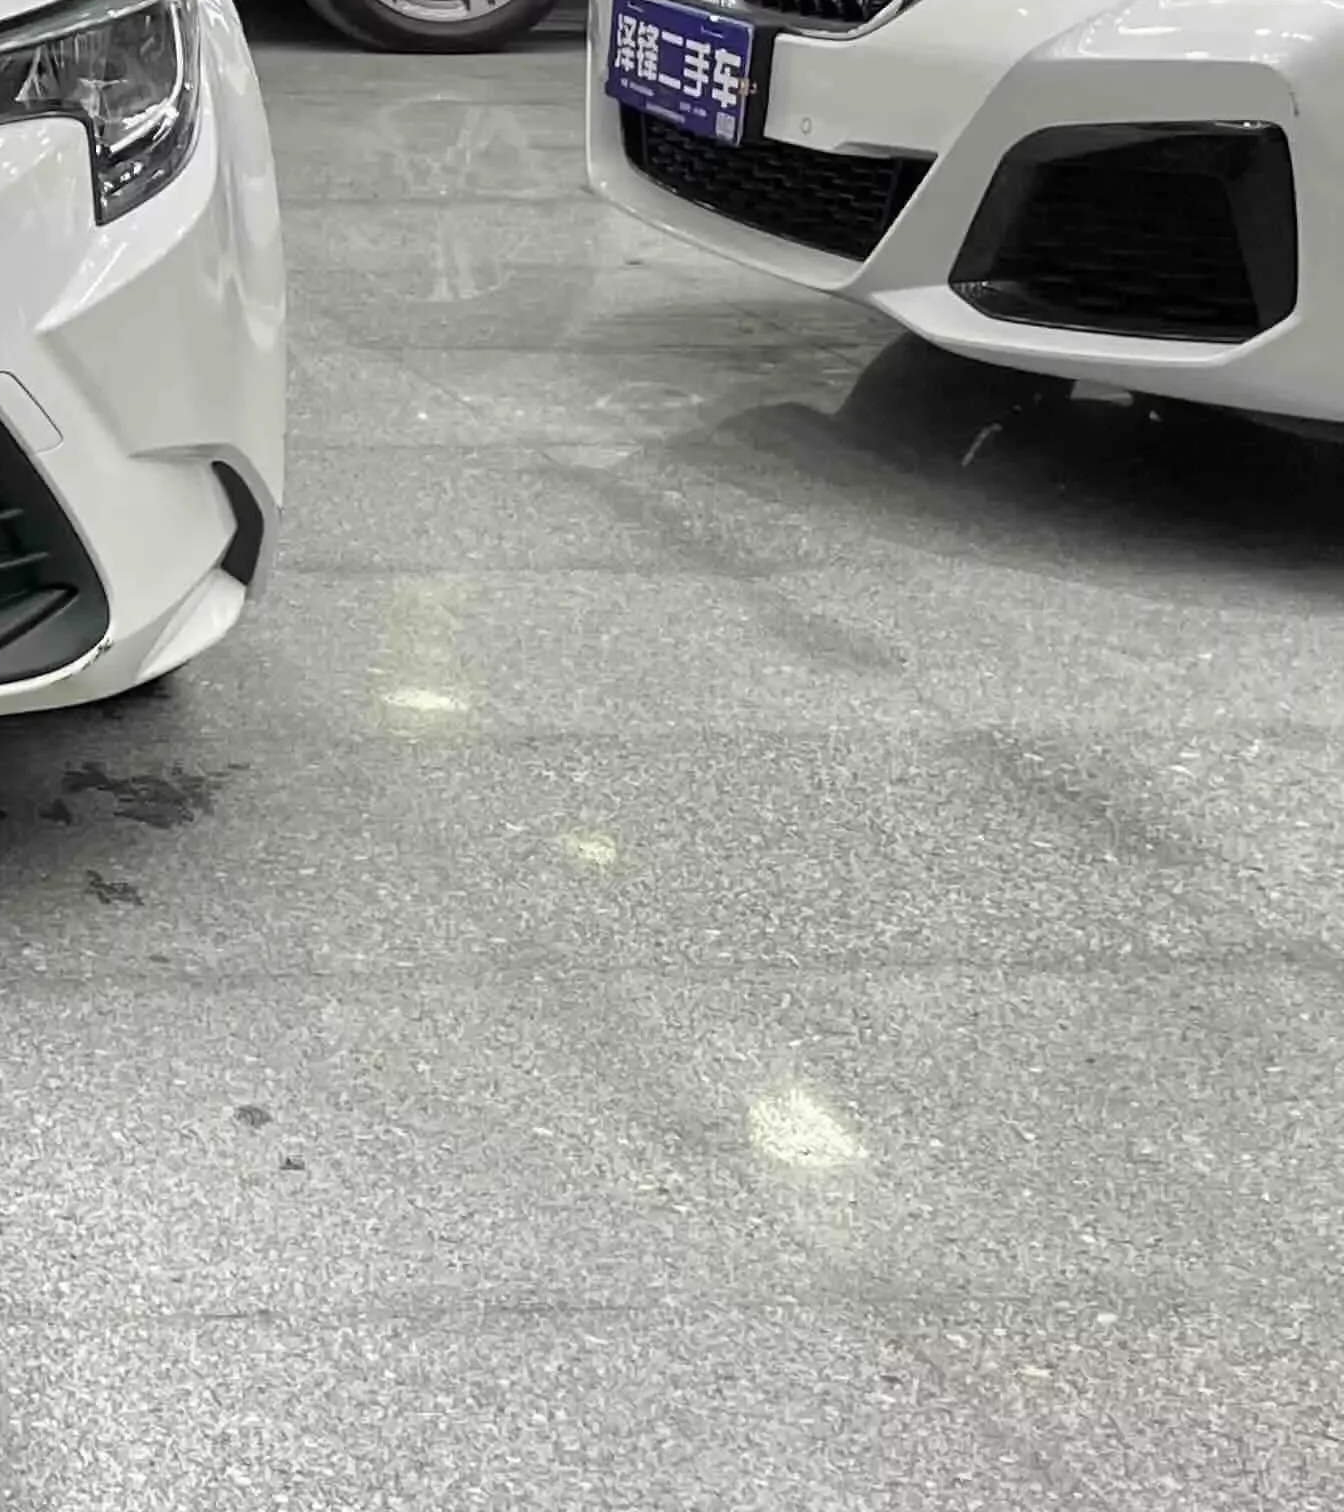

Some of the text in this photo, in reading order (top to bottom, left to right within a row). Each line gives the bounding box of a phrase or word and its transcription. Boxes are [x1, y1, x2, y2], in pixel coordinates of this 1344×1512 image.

[614, 13, 742, 108] 泽锋二手车
